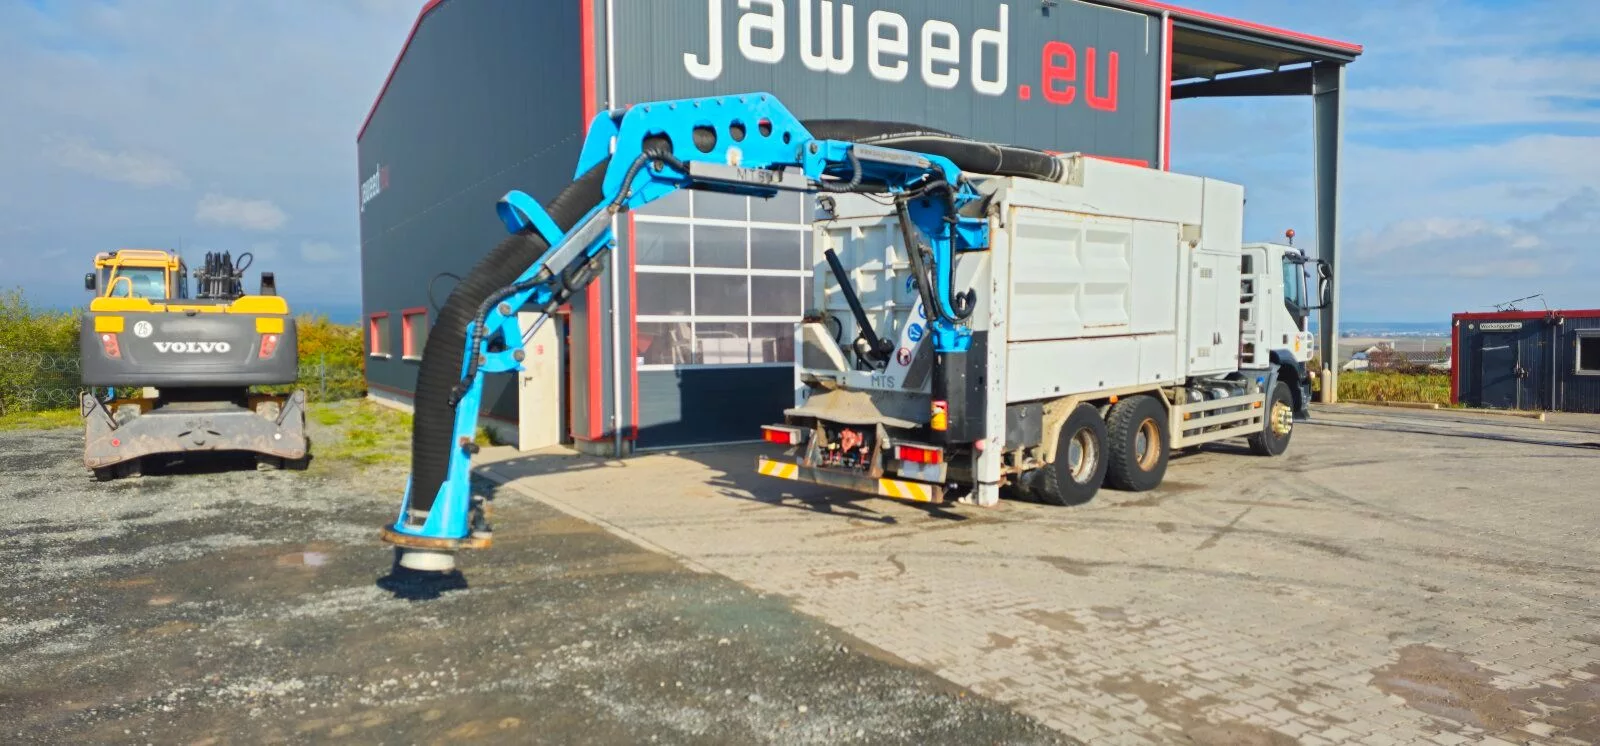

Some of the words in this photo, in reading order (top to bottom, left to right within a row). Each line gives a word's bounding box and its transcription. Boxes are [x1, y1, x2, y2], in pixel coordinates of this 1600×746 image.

[684, 0, 1118, 111] jaweed.eu
[138, 322, 147, 335] 25
[153, 342, 231, 353] VOLVO
[871, 375, 895, 388] MTS
